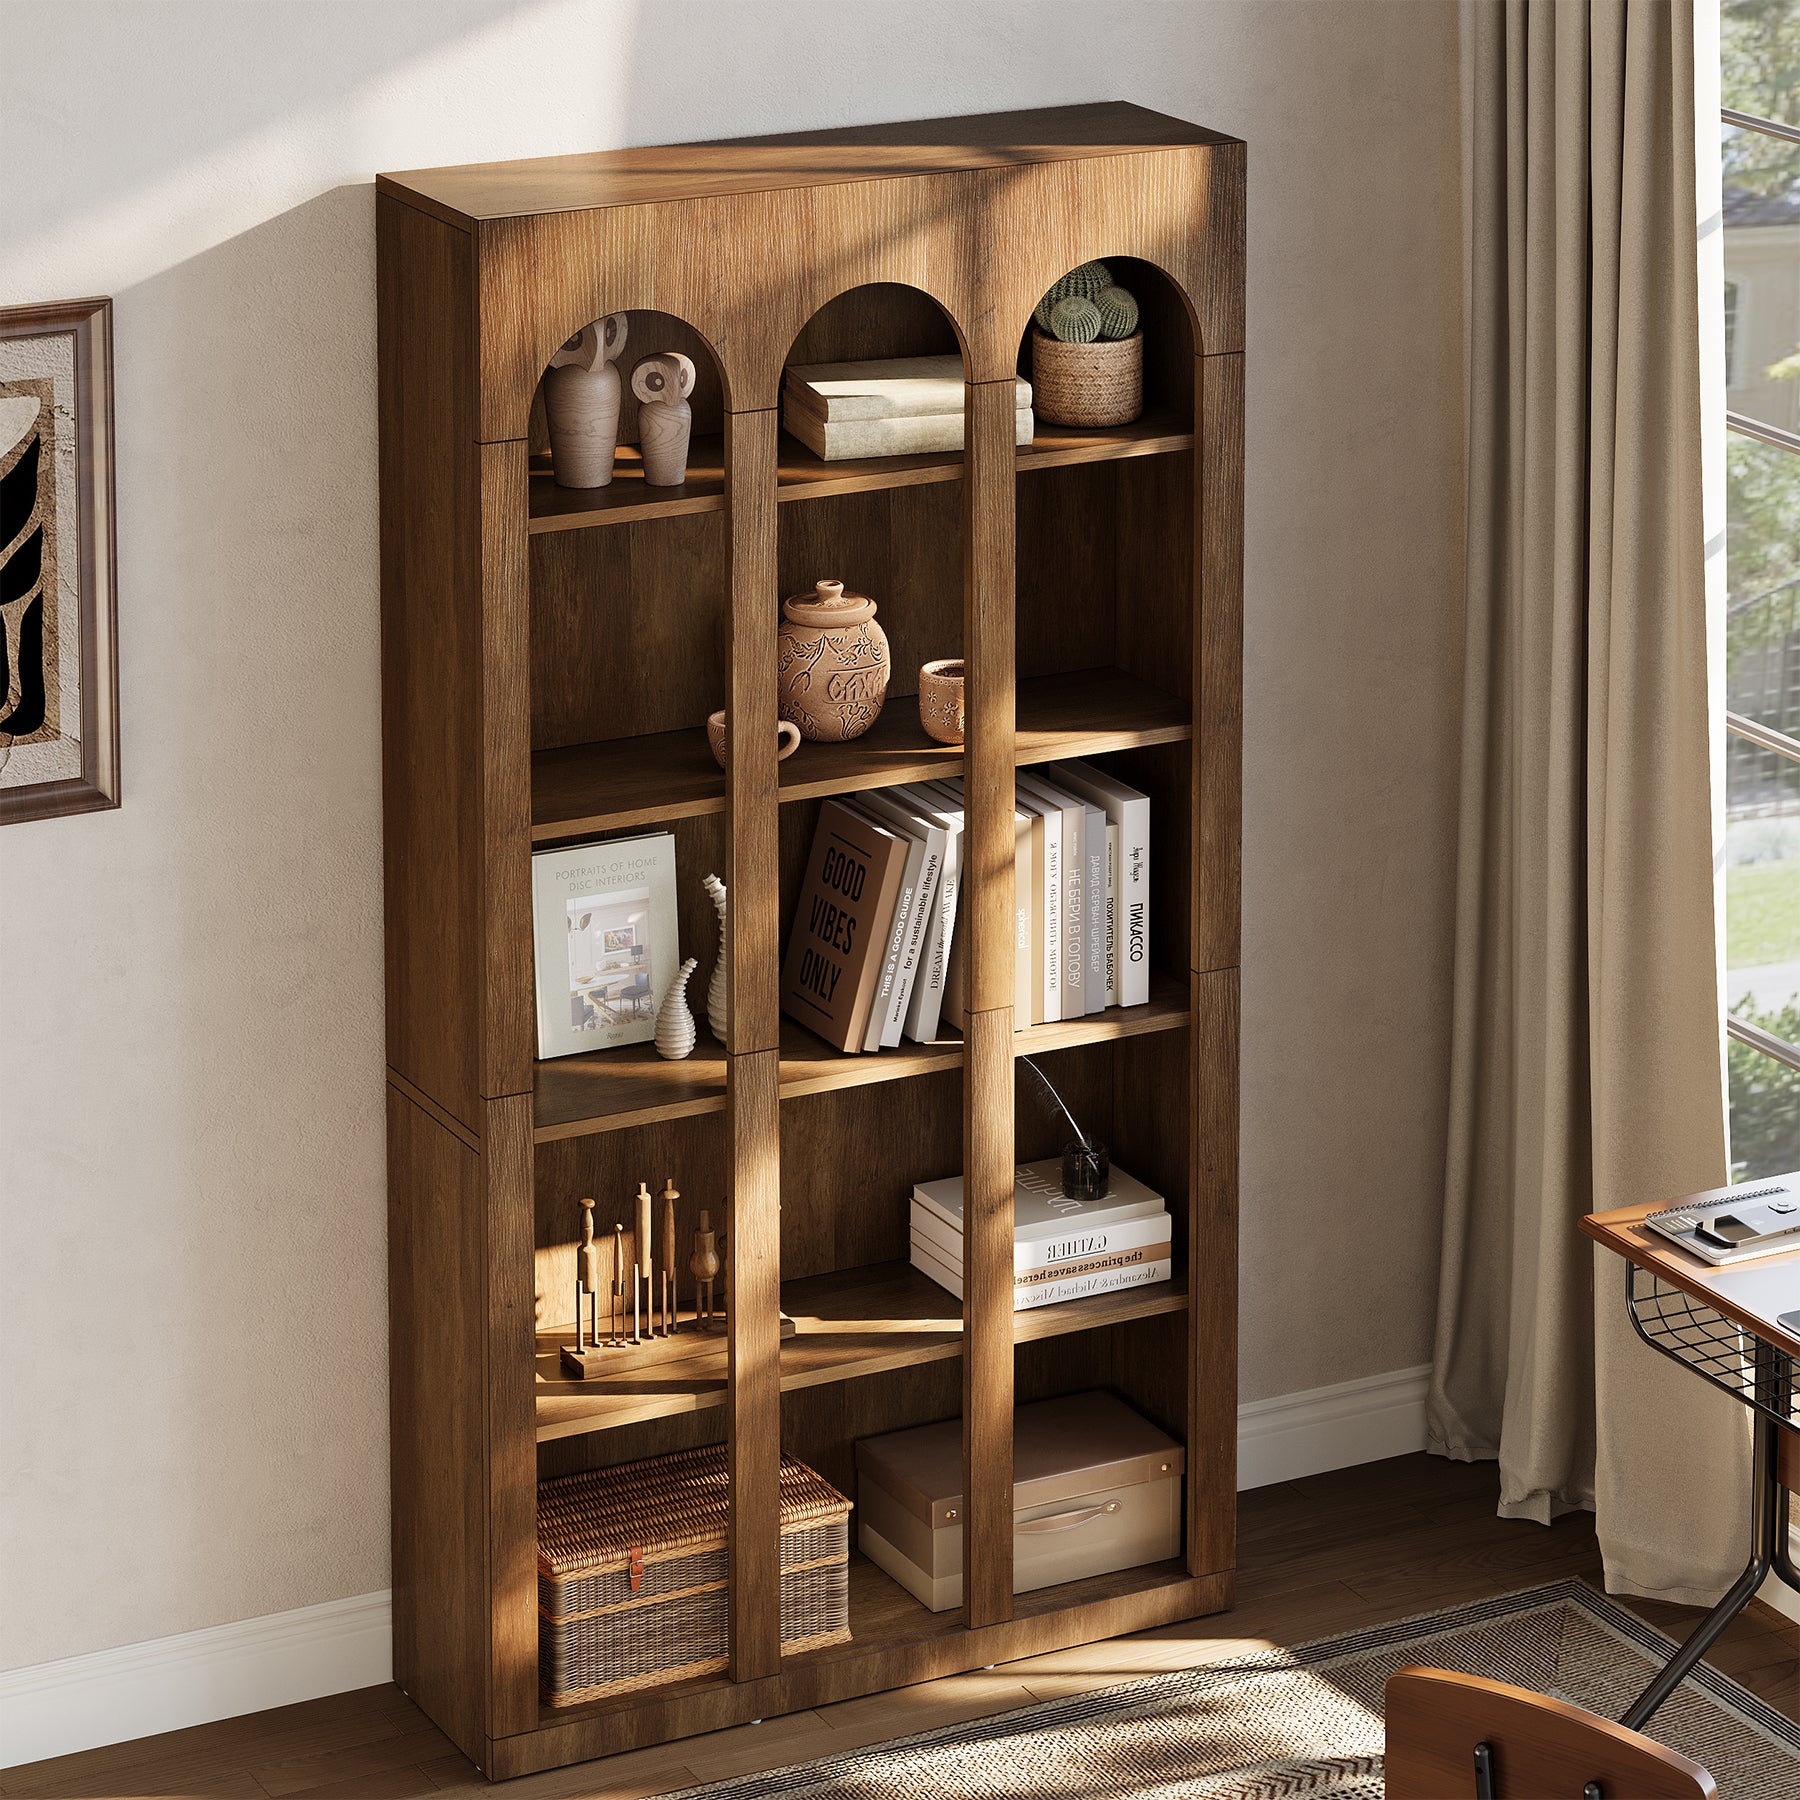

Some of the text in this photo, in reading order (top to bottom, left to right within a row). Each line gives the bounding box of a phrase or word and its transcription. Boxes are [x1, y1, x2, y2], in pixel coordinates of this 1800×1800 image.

[555, 856, 657, 880] PORTRAITS OF HOME
[569, 871, 646, 891] DISC INTERIORS
[822, 846, 866, 903] GOOD
[1068, 868, 1081, 886] НЕ
[1090, 855, 1100, 887] ДАВИД
[809, 895, 856, 955] VIBES
[903, 956, 914, 971] for
[909, 892, 929, 946] sustainable
[921, 853, 938, 891] lifestyle
[1068, 888, 1081, 923] БЕРИ
[1068, 925, 1081, 935] В
[1129, 903, 1144, 962] ПИКАССО
[880, 887, 913, 998] THIS IS A GOOD GUIDE
[929, 950, 944, 989] DREAM
[942, 879, 956, 915] AWAKE
[1106, 897, 1114, 991] ПОХИТИТЕЛЬ БАБОЧЕК
[800, 948, 841, 1003] ONLY
[1068, 936, 1081, 988] ГОЛОВУ
